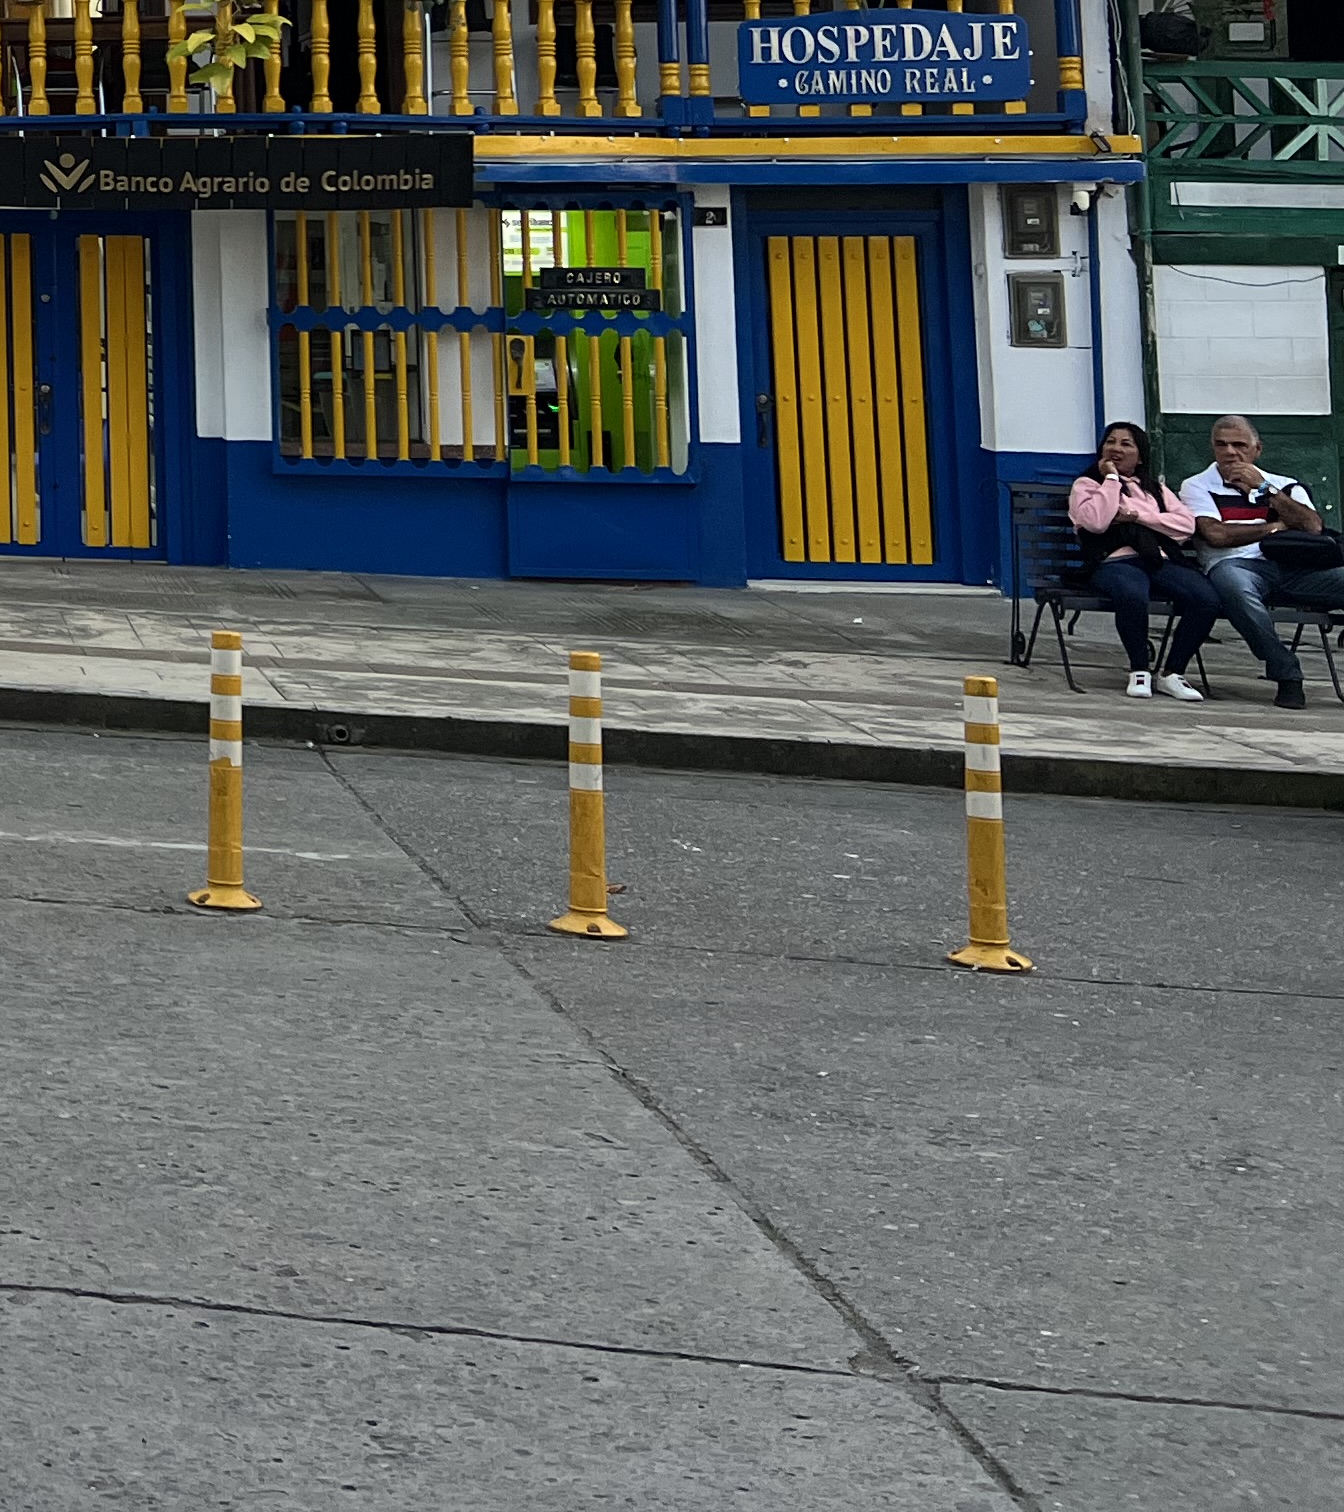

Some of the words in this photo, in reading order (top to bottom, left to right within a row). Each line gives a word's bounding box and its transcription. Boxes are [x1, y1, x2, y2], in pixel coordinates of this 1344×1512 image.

[748, 21, 1020, 64] HOSPEDAJE
[794, 68, 892, 95] CAMINO
[904, 67, 977, 94] REAL
[99, 170, 173, 193] Banco
[180, 171, 270, 198] Agrario
[280, 172, 310, 193] de
[321, 168, 434, 191] Colombia
[566, 272, 621, 284] CAJERO
[547, 293, 641, 306] AUTOMATICO
